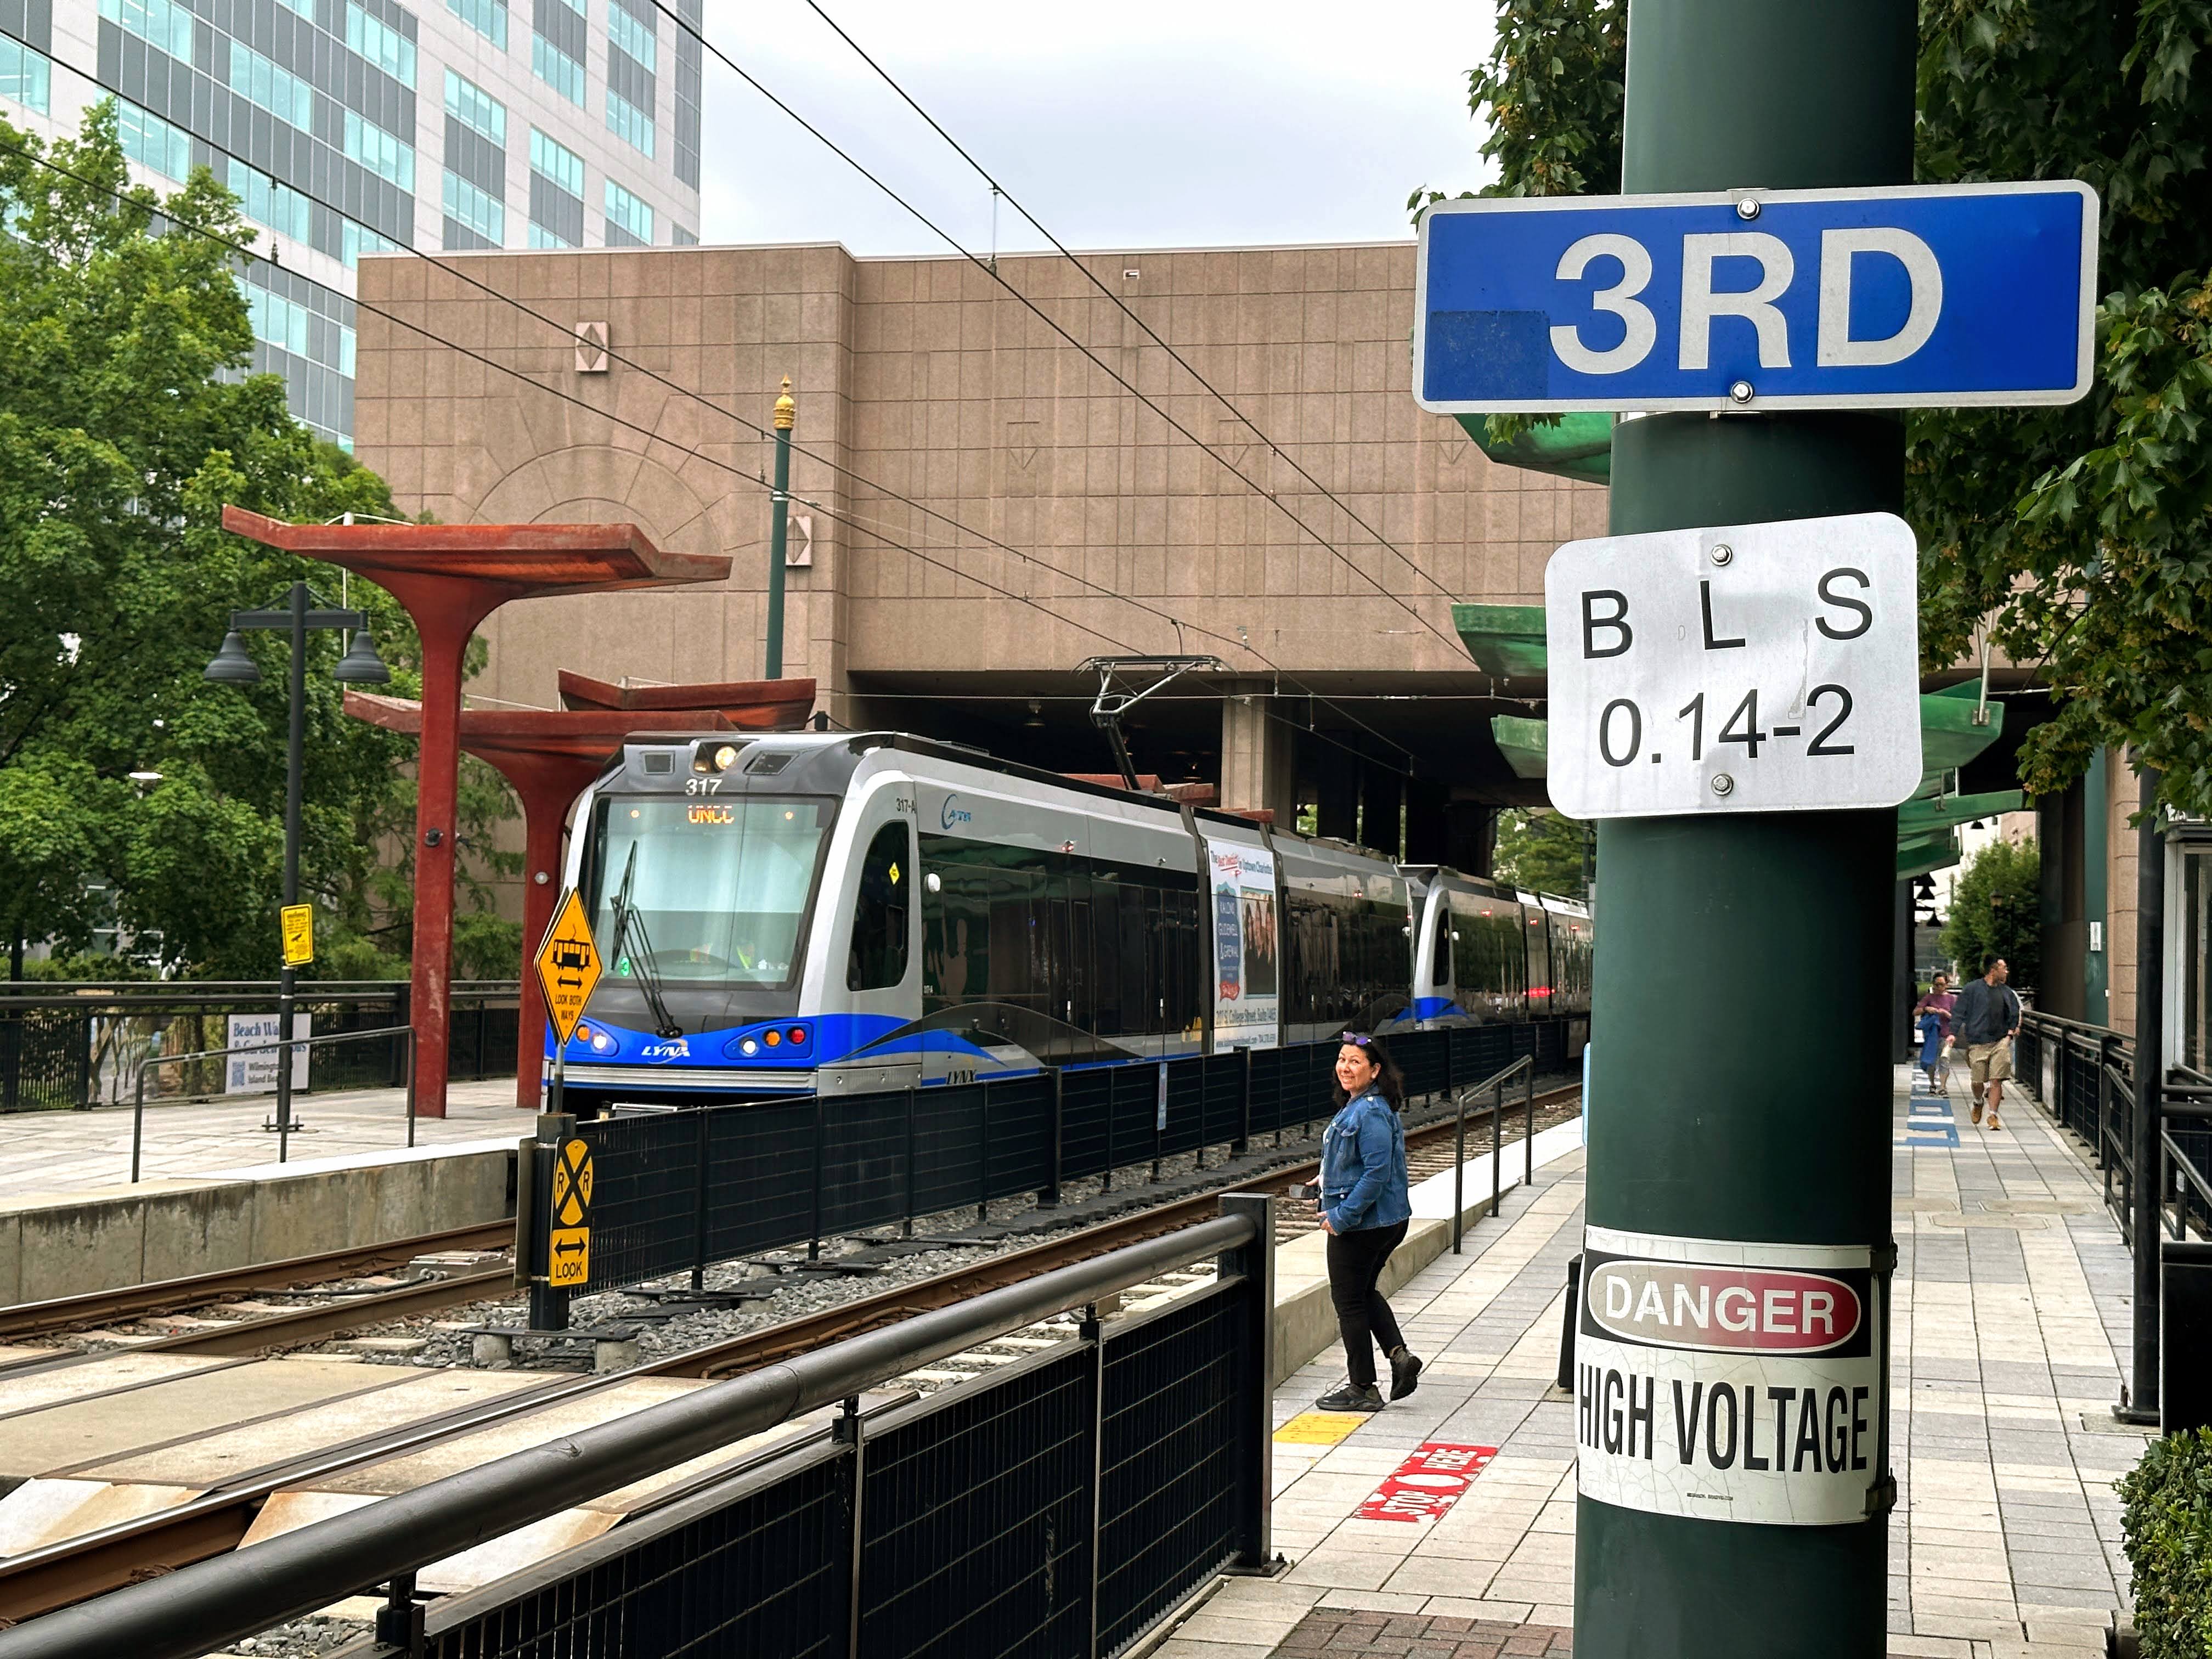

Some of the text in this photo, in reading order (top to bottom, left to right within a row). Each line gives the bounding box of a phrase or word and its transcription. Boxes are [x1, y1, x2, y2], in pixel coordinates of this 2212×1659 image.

[1549, 227, 1943, 375] 3RD
[1581, 567, 1873, 659] B L S
[1599, 684, 1855, 768] 0.14-2
[685, 778, 723, 796] 317
[687, 805, 735, 824] UNCC
[555, 994, 582, 1006] LOOK BOTH
[561, 1010, 574, 1021] WAYS
[233, 1022, 261, 1037] Beach
[641, 1045, 691, 1057] LYNX
[556, 1170, 590, 1193] R R
[555, 1261, 583, 1279] LOOK
[1605, 1274, 1835, 1335] DANGER
[1579, 1362, 1869, 1474] HIGH VOLTAGE
[1379, 1448, 1478, 1516] STOP HERE
